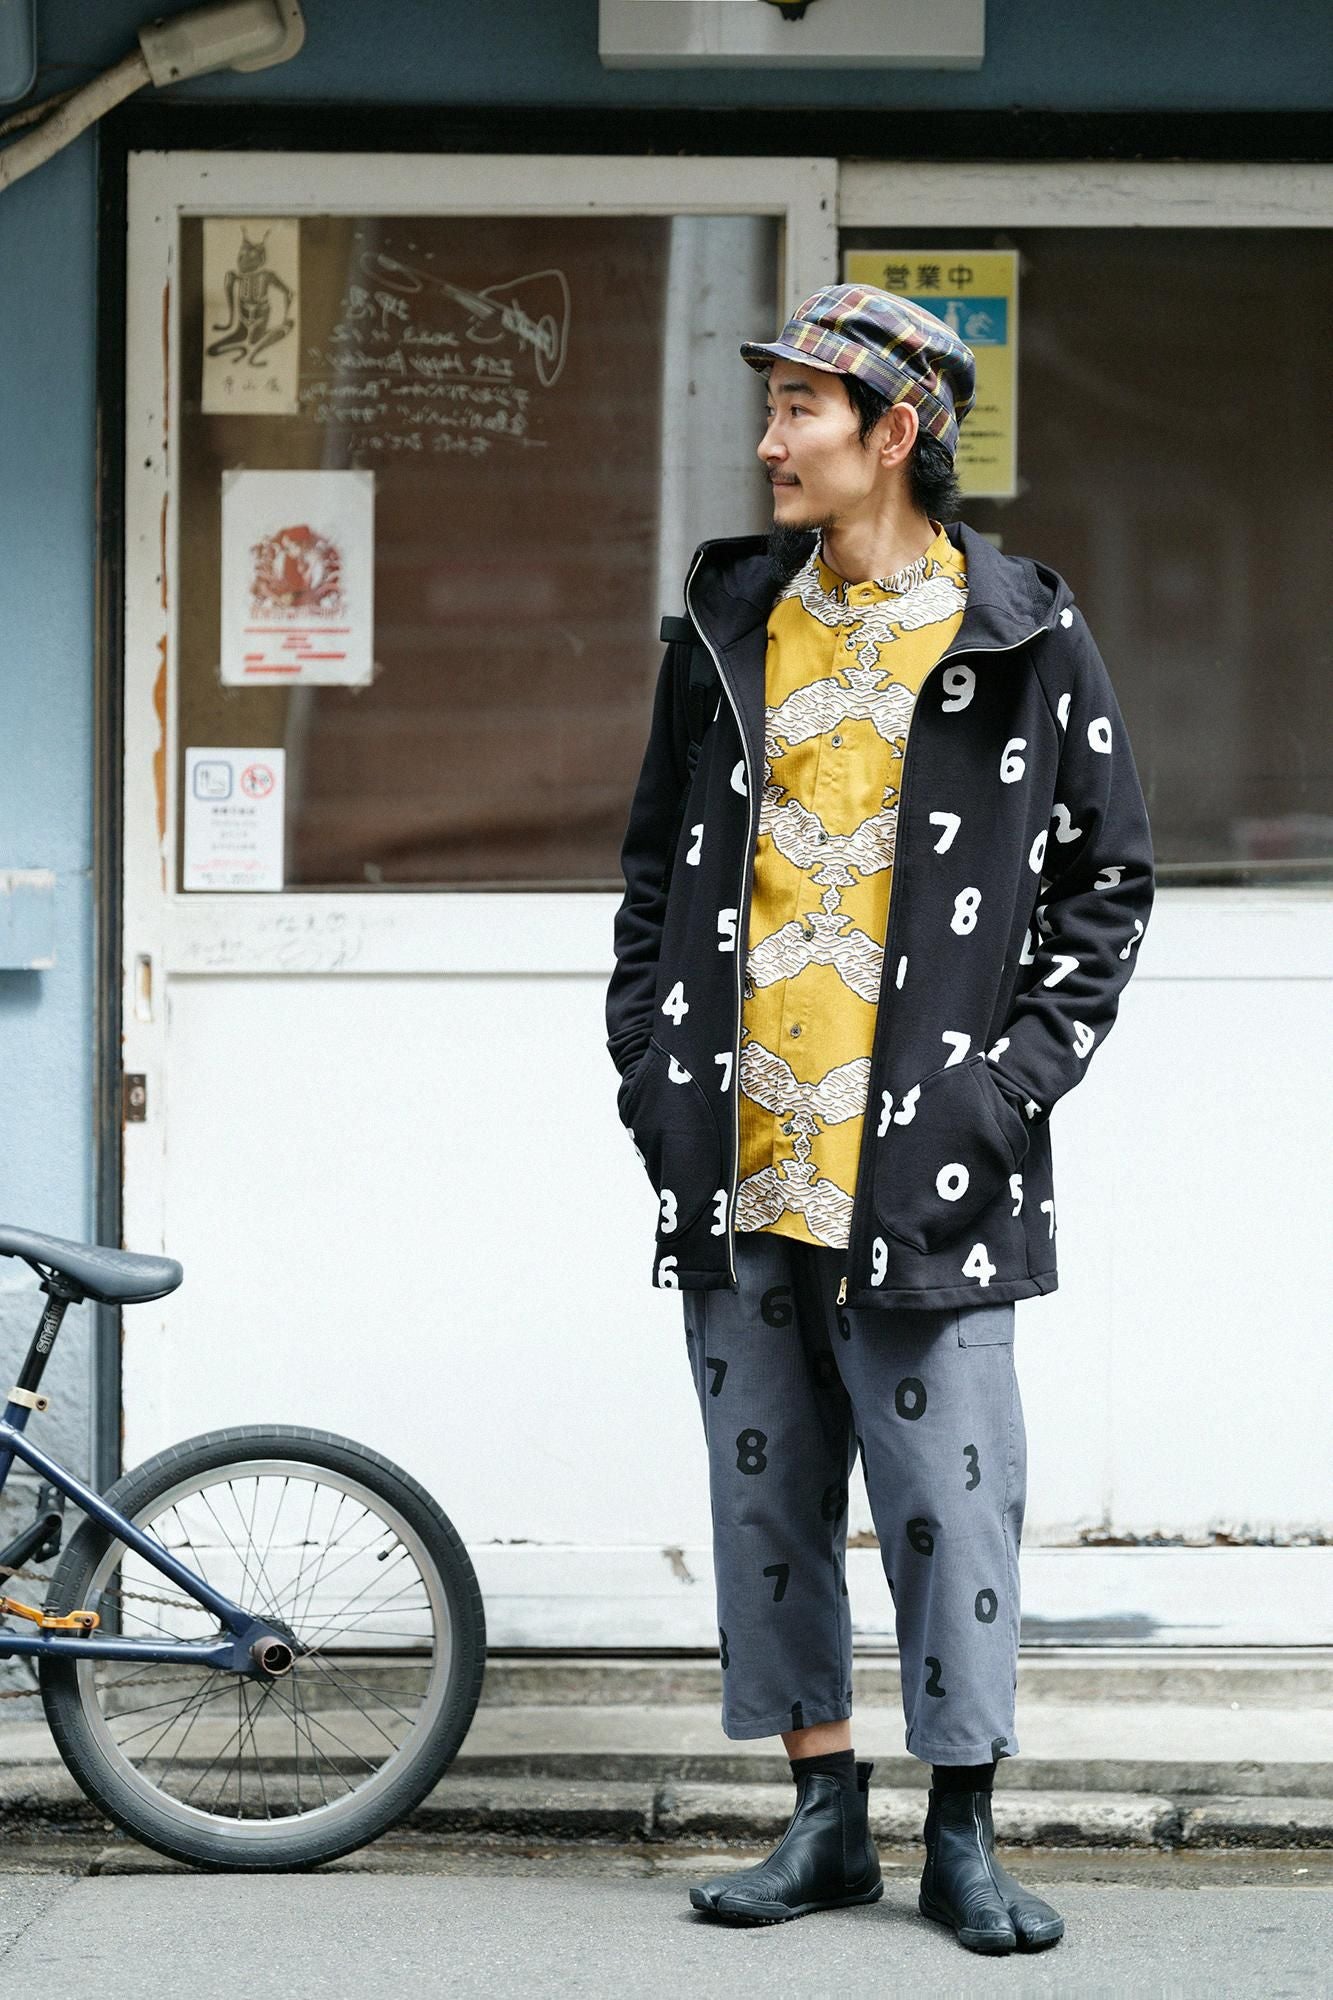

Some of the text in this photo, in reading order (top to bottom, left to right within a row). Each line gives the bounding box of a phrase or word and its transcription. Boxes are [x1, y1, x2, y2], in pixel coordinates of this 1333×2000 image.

[883, 263, 974, 291] 営業中
[942, 666, 975, 712] 9
[1000, 738, 1027, 784] 6
[929, 812, 961, 854] 7
[1054, 804, 1082, 843] 2
[718, 909, 737, 951] 5
[950, 887, 981, 935] 8
[1044, 955, 1079, 987] 7
[662, 981, 689, 1025] 4
[942, 1031, 971, 1069] 7
[1073, 1021, 1095, 1058] 9
[715, 1052, 733, 1092] 7
[936, 1163, 969, 1201] 0
[1009, 1174, 1023, 1216] 5
[661, 1189, 677, 1233] 3
[711, 1189, 728, 1236] 3
[658, 1255, 679, 1290] 6
[871, 1237, 888, 1286] 9
[962, 1243, 996, 1287] 4
[761, 1286, 790, 1327] 6
[706, 1357, 727, 1396] 7
[895, 1377, 927, 1420] 0
[736, 1429, 767, 1475] 8
[963, 1444, 981, 1491] 3
[907, 1518, 934, 1556] 6
[763, 1563, 789, 1602] 7
[975, 1589, 998, 1623] 0
[925, 1657, 946, 1697] 2
